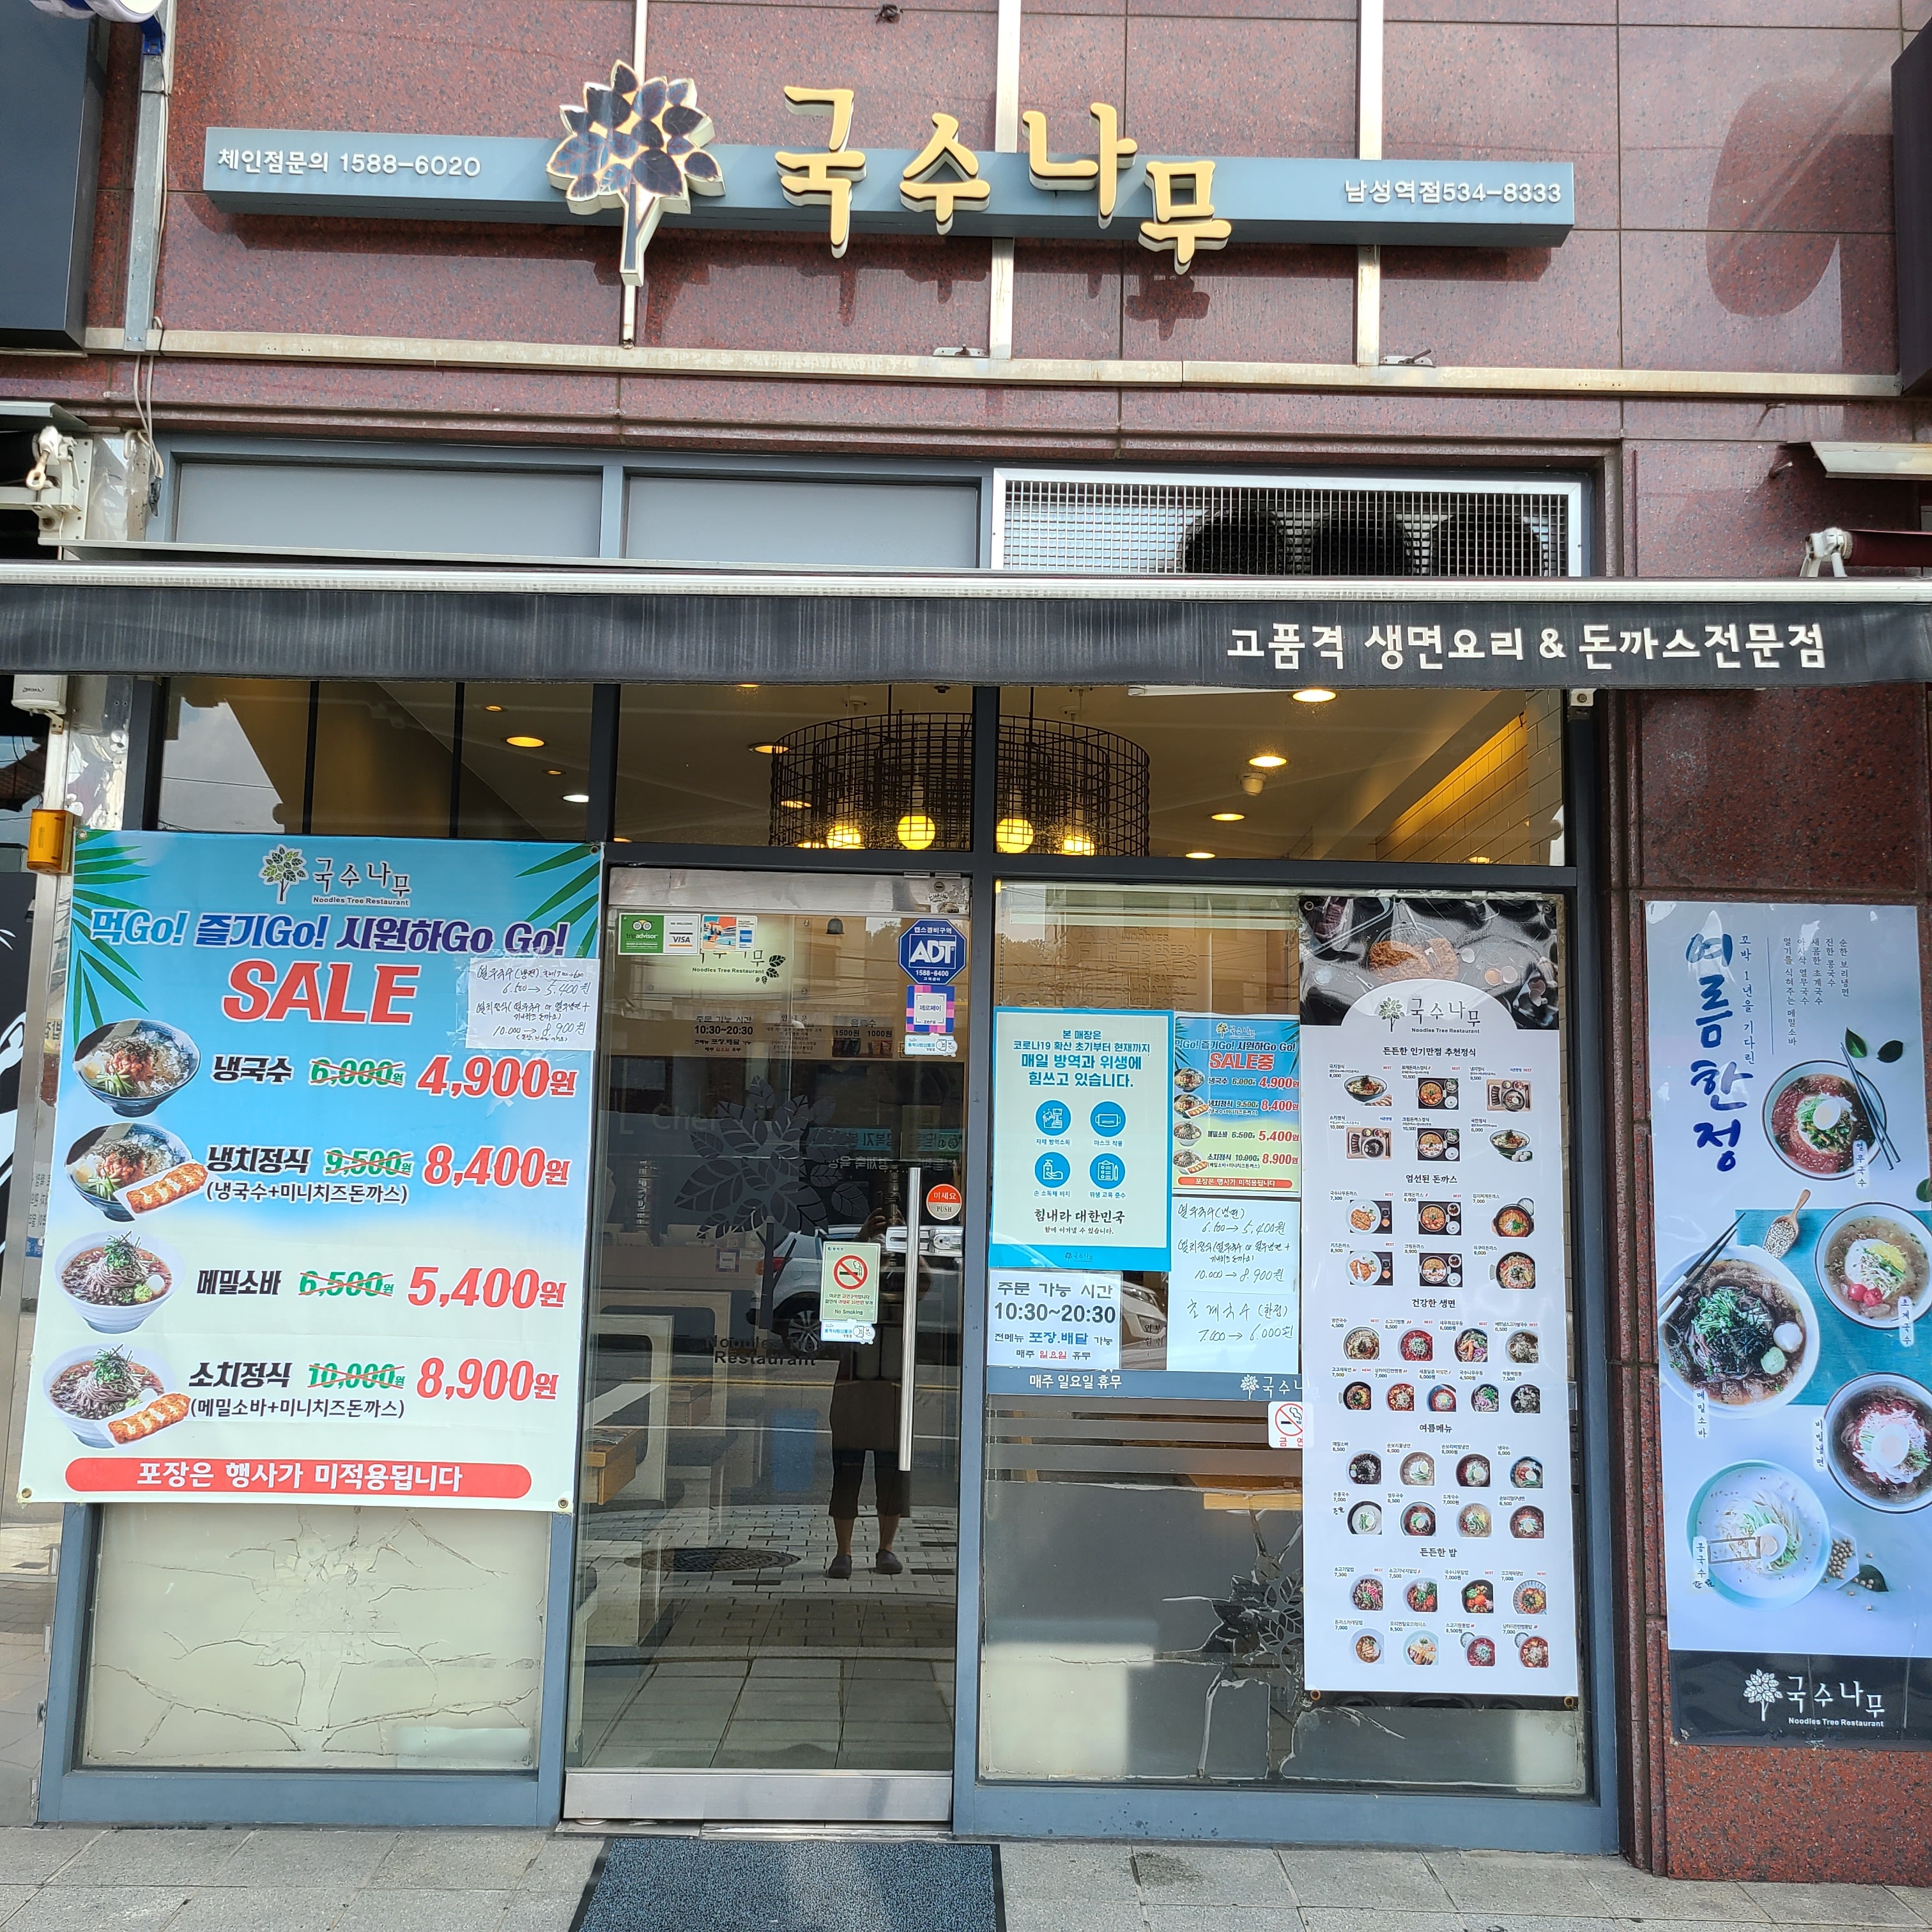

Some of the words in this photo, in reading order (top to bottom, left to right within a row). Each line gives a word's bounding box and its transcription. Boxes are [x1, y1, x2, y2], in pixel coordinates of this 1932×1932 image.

[218, 148, 328, 175] 체인점문의
[340, 153, 481, 178] 1588-6020
[775, 85, 1232, 272] 국수나무
[1344, 179, 1561, 205] 남성역점534-8333
[1227, 622, 1345, 671] 고품격
[1364, 623, 1524, 671] 생면요리
[1538, 628, 1567, 659] &
[1578, 622, 1825, 670] 돈까스전문점
[313, 856, 412, 899] 국수나무
[313, 896, 346, 905] Noodles
[347, 898, 364, 906] Tree
[365, 898, 409, 907] Restaurant
[91, 909, 187, 946] 먹Go!
[195, 914, 325, 951] 즐기Go!
[336, 917, 494, 954] 시원하Go
[502, 921, 569, 956] Go!
[910, 940, 956, 964] ADT
[1739, 935, 1752, 962] 꼬박
[1811, 938, 1821, 965] 새콤한
[1825, 939, 1834, 956] 진한
[1839, 939, 1848, 956] 순한
[1827, 960, 1836, 986] 콩국수
[1840, 961, 1849, 997] 보리냉면
[224, 961, 420, 1023] SALE
[1742, 970, 1754, 1013] 1년을
[1799, 969, 1809, 1005] 열무국수
[1813, 969, 1823, 1005] 초계국수
[1411, 997, 1481, 1027] 국수나무
[694, 1025, 753, 1035] 10:30~20:30
[834, 1029, 859, 1037] 1500원
[868, 1030, 892, 1038] 1000원
[1062, 1030, 1071, 1039] 본
[1075, 1030, 1101, 1040] 매장은
[1787, 1009, 1797, 1045] 메밀소바
[1013, 1040, 1051, 1050] 코로나19
[1054, 1041, 1072, 1051] 확산
[1075, 1042, 1111, 1052] 초기부터
[1201, 1041, 1234, 1050] 즐기Go!
[1237, 1041, 1276, 1051] 시원하Go
[1279, 1043, 1295, 1052] Go!
[1383, 1046, 1408, 1057] 든든한
[1410, 1046, 1441, 1057] 인기만점
[1444, 1047, 1476, 1057] 추천정식
[1685, 932, 1754, 1172] 여름한정
[1744, 1020, 1756, 1065] 기다린
[1022, 1054, 1048, 1068] 매일
[1054, 1054, 1095, 1069] 방역과
[1100, 1055, 1142, 1070] 위생에
[1209, 1053, 1273, 1070] SALE중
[211, 1054, 293, 1084] 냉국수
[310, 1057, 405, 1089] 6,000원
[417, 1055, 578, 1100] 4,900원
[1029, 1071, 1069, 1086] 힘쓰고
[1075, 1073, 1134, 1087] 있습니다.
[1259, 1078, 1299, 1088] 4,900원
[1261, 1100, 1299, 1110] 8,400원
[1259, 1131, 1299, 1142] 5,400원
[206, 1145, 309, 1175] 냉치정식
[324, 1148, 412, 1178] 9,500원
[424, 1145, 571, 1189] 8,400원
[1262, 1154, 1298, 1164] 8,900원
[1855, 1141, 1866, 1187] 열무국수
[1406, 1174, 1430, 1184] 엄선된
[1432, 1175, 1459, 1184] 돈까스
[206, 1180, 408, 1204] (냉국수+미니치즈돈까스)
[933, 1192, 956, 1200] 미세요
[1034, 1208, 1071, 1223] 힘내라
[1075, 1209, 1126, 1225] 대한민국
[1087, 1227, 1114, 1235] 있습니다.
[197, 1270, 282, 1297] 메밀소바
[298, 1271, 395, 1298] 6,500원
[408, 1266, 567, 1311] 5,400원
[997, 1282, 1030, 1296] 주문
[1038, 1282, 1071, 1298] 가능
[1080, 1284, 1113, 1299] 시간
[994, 1302, 1116, 1324] 10:30~20:30
[1412, 1298, 1437, 1308] 건강한
[1439, 1298, 1456, 1308] 생면
[995, 1333, 1024, 1342] 전메뉴
[1029, 1331, 1088, 1345] 포장.배달
[1094, 1337, 1113, 1346] 가능
[714, 1351, 815, 1366] Restaurant
[1016, 1349, 1035, 1359] 매주
[1039, 1350, 1067, 1360] 일요일
[1072, 1351, 1091, 1360] 휴무
[189, 1362, 293, 1389] 소치정식
[307, 1363, 406, 1390] 10,000원
[416, 1357, 560, 1402] 8,900원
[1029, 1375, 1054, 1389] 매주
[1058, 1375, 1093, 1390] 일요일
[1097, 1375, 1122, 1390] 휴무
[190, 1397, 405, 1420] (메밀소바+미니치즈돈까스)
[1696, 1390, 1707, 1438] 메밀소바
[1419, 1423, 1453, 1434] 여름메뉴
[136, 1464, 215, 1487] 포장은
[226, 1463, 303, 1490] 행사가
[314, 1464, 463, 1493] 미적용됩니다
[1420, 1548, 1445, 1559] 든든한
[1448, 1548, 1457, 1558] 밥
[1786, 1676, 1885, 1718] 국수나무
[1788, 1716, 1820, 1725] Noodles
[1821, 1717, 1838, 1726] Tree
[1840, 1719, 1884, 1728] Restaurant
